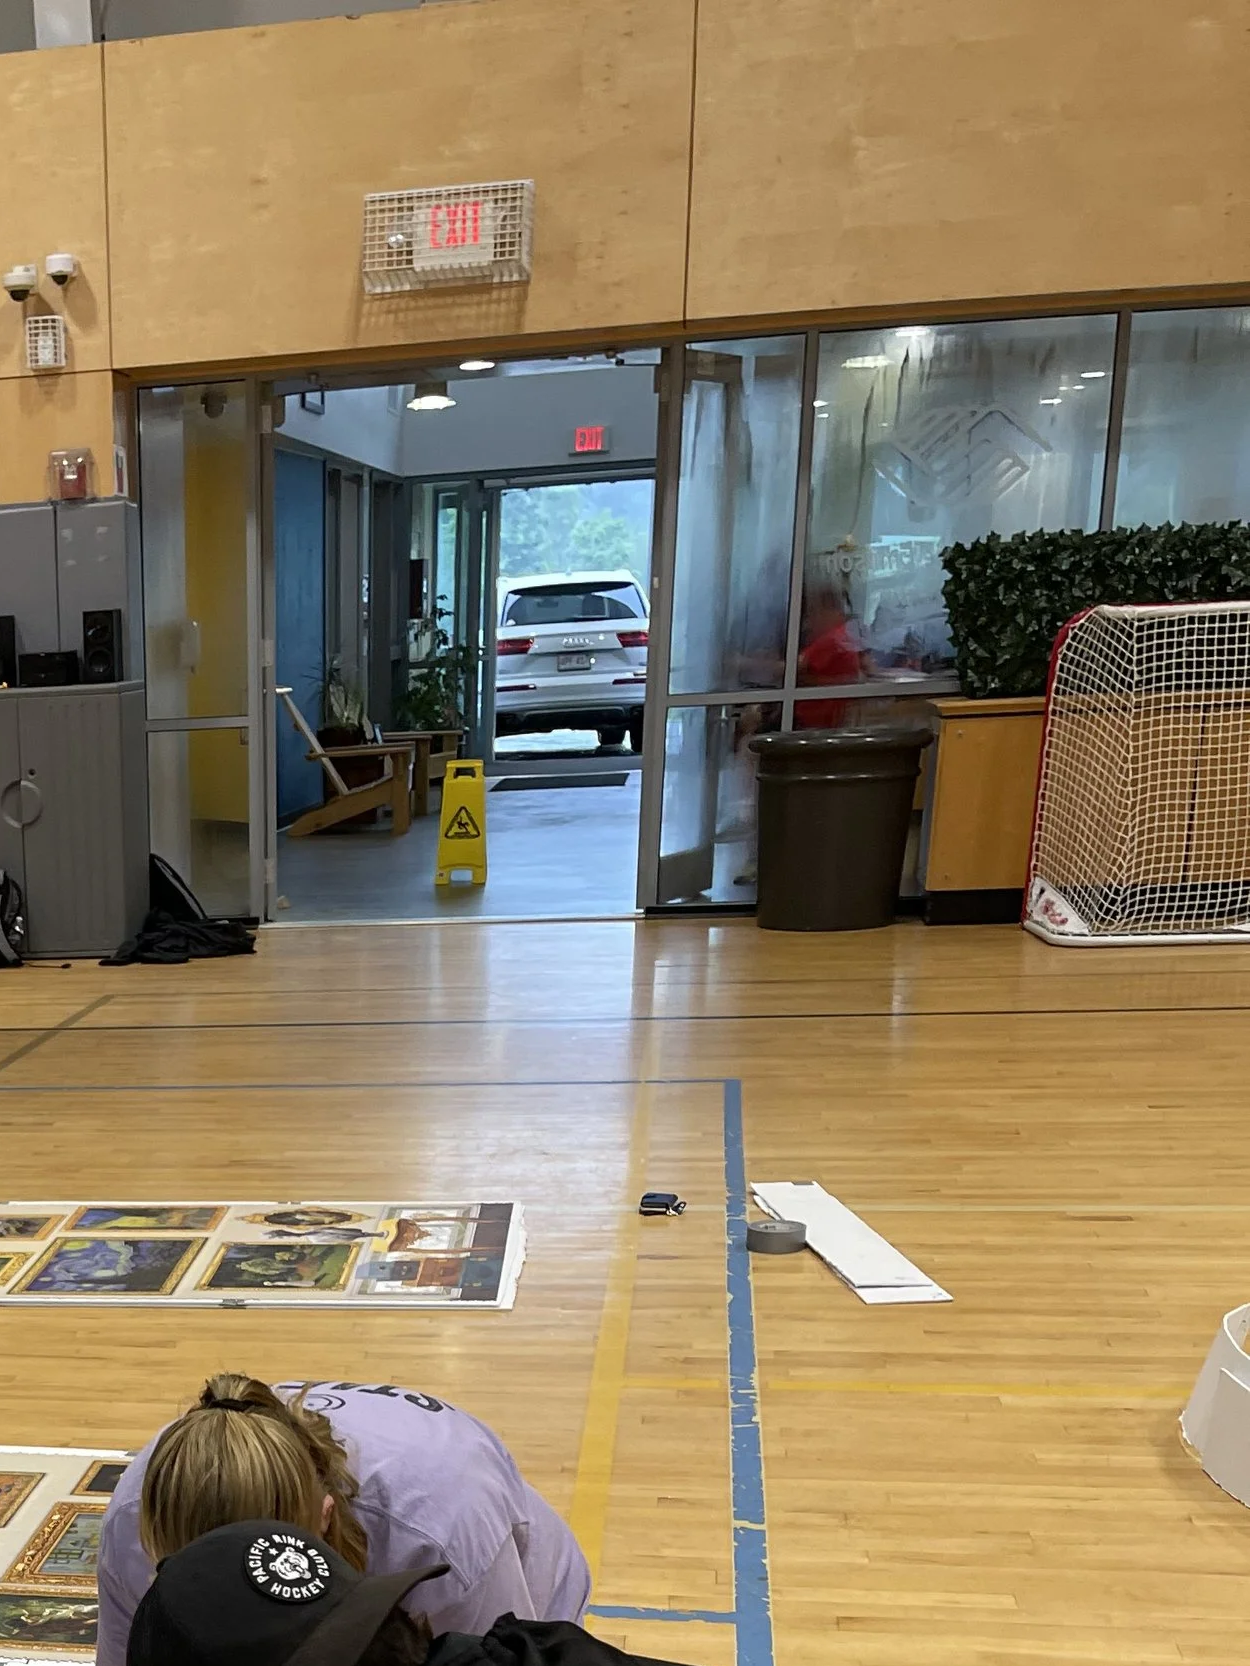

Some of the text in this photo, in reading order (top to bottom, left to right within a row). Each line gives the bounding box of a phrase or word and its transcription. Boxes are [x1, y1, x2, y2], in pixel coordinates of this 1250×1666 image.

[429, 201, 483, 249] EXIT
[575, 426, 605, 451] EXIT
[249, 1538, 270, 1583] PACIFIC
[270, 1549, 330, 1598] HOCKEY CLUB
